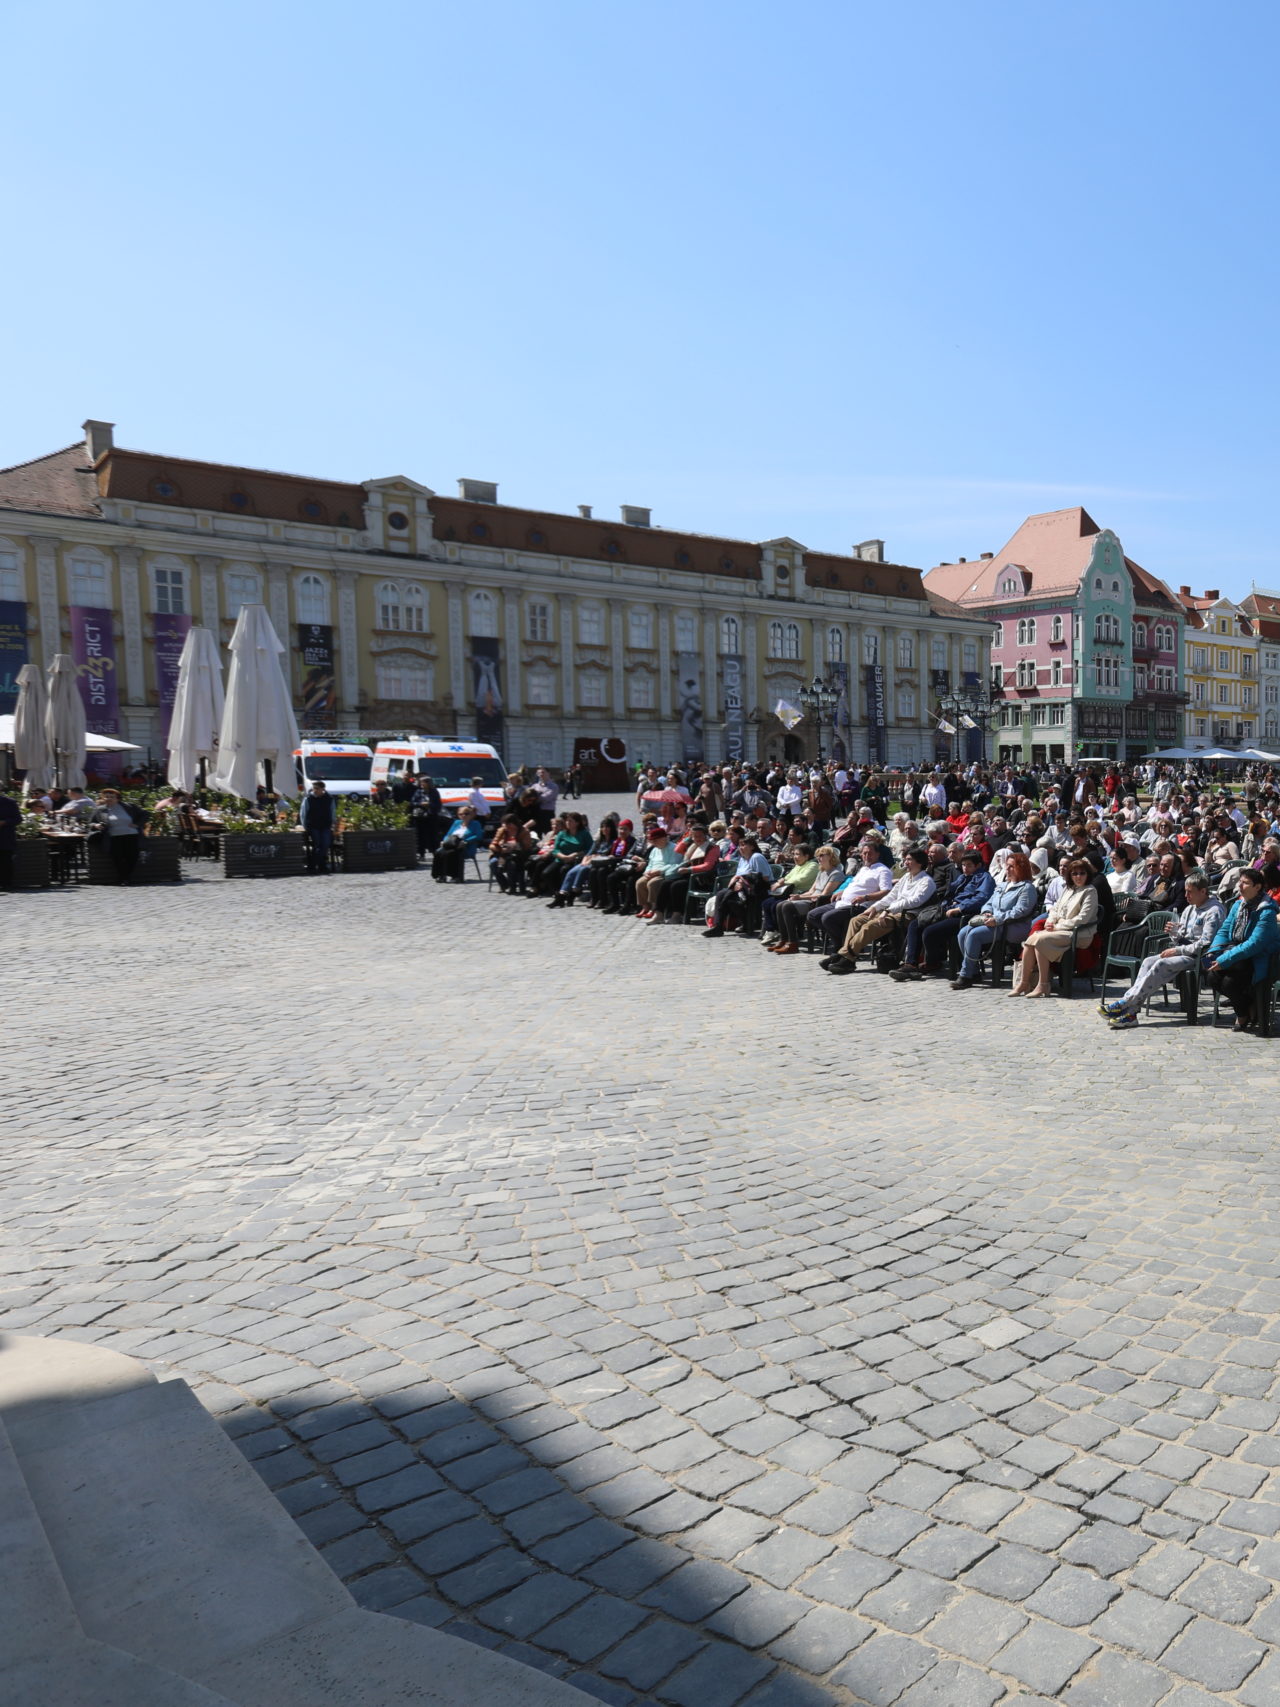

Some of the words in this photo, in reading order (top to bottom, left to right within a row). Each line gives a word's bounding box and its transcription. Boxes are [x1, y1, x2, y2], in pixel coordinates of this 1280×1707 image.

[726, 660, 742, 720] NEAGU
[579, 749, 596, 760] art
[729, 726, 742, 760] AUL
